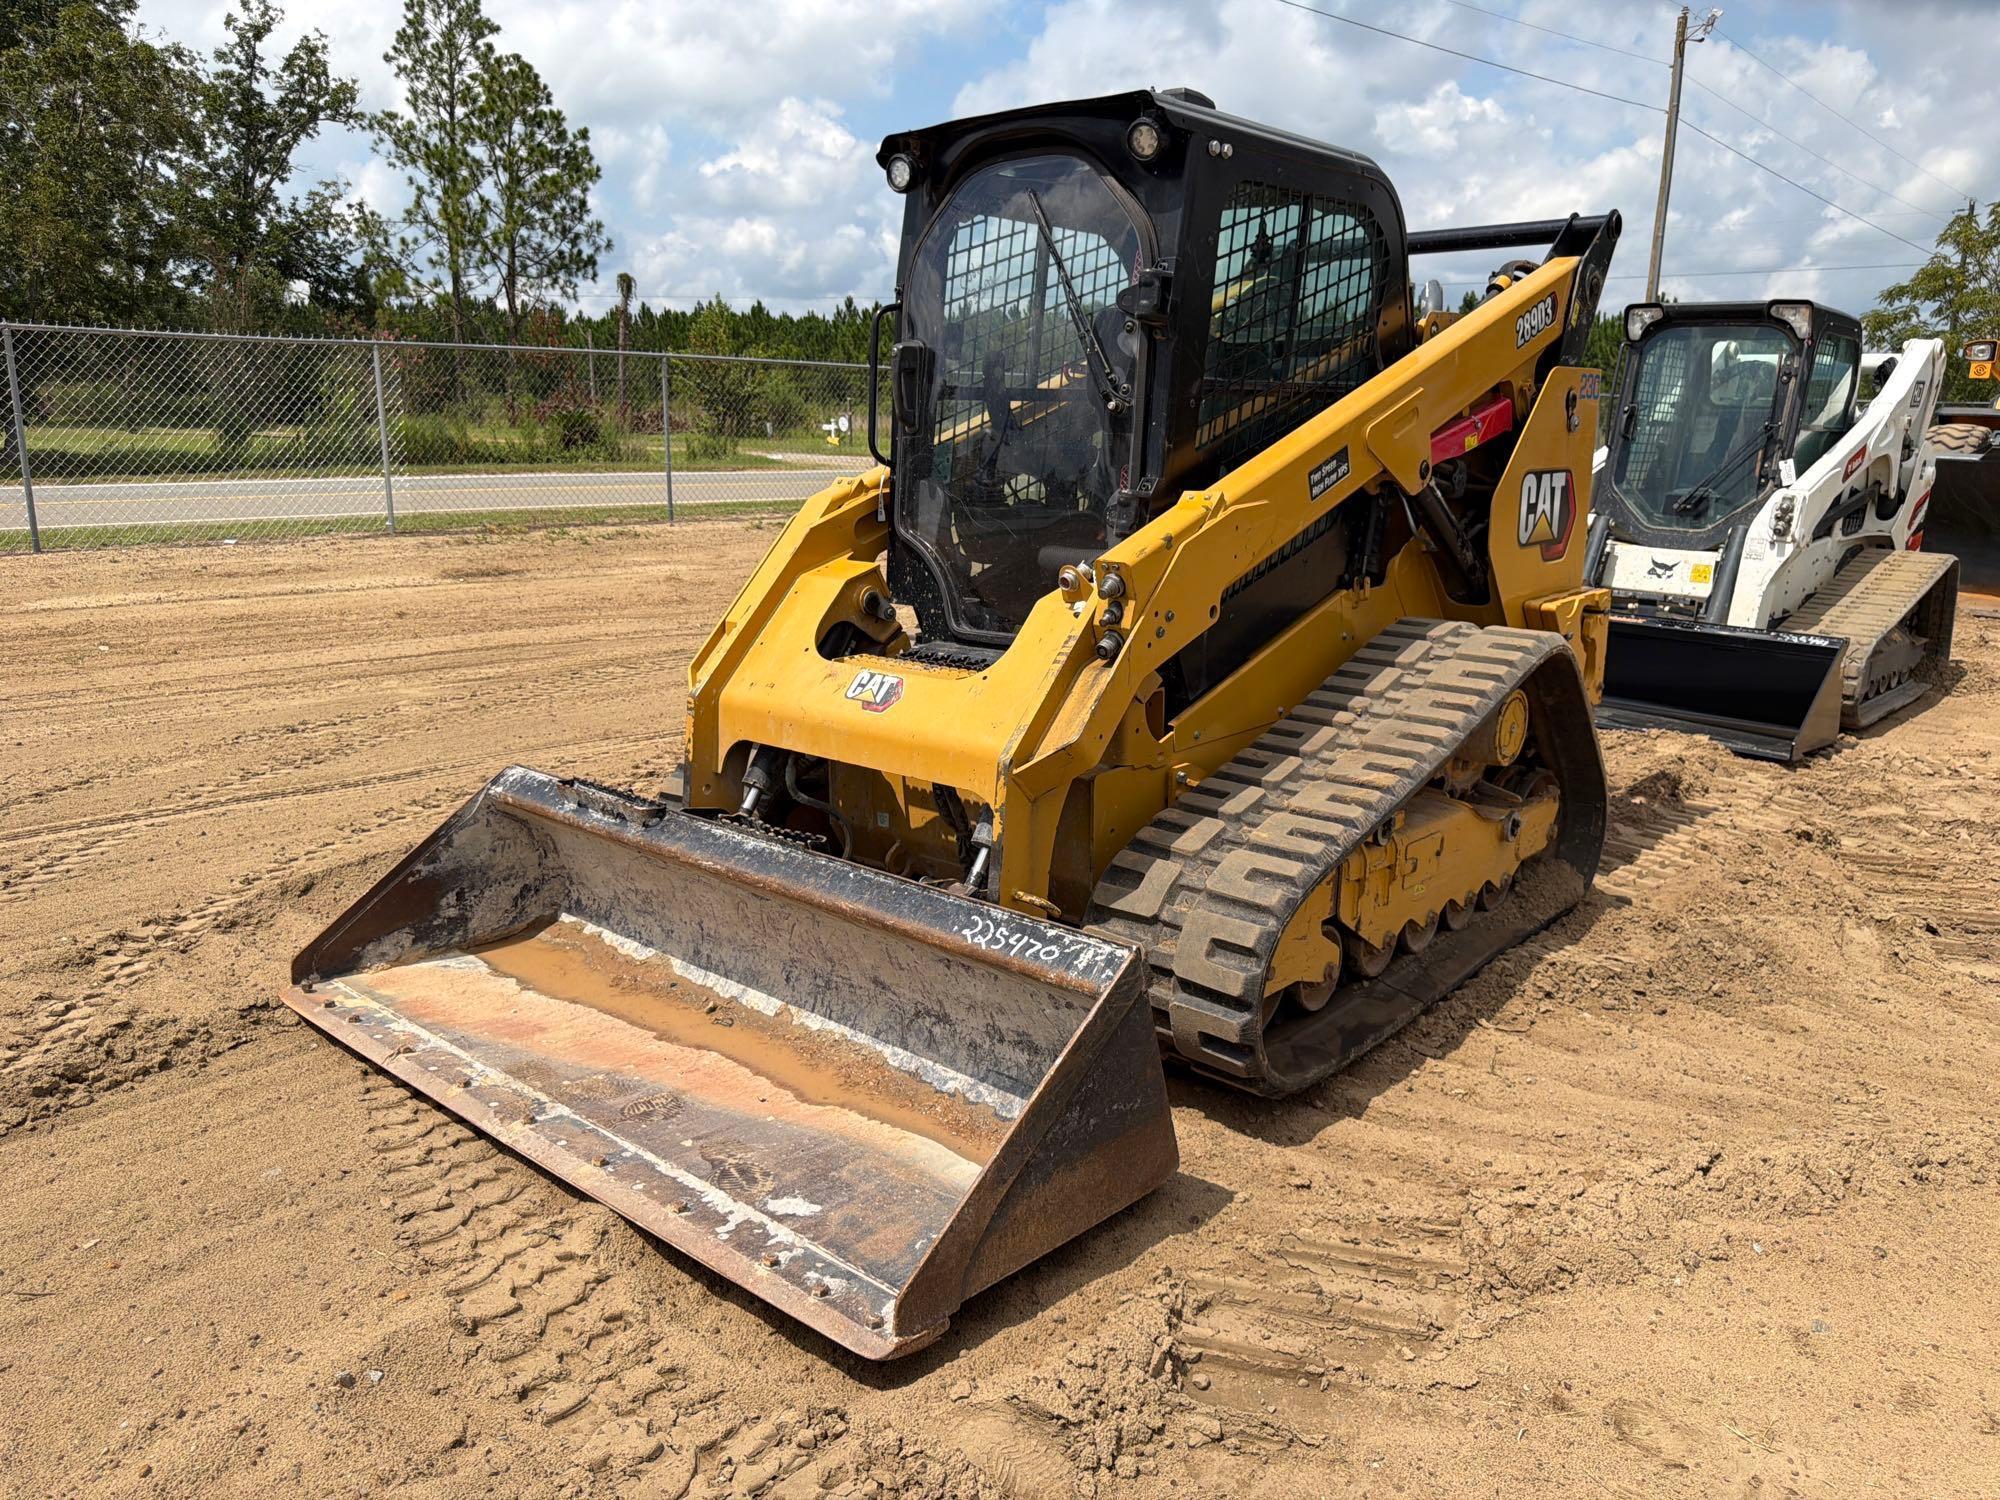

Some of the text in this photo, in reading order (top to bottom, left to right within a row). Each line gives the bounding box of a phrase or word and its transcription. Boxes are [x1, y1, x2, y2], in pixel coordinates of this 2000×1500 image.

[1515, 295, 1553, 348] 289D3
[1518, 471, 1567, 545] CAT
[845, 669, 901, 704] CAT
[961, 915, 1060, 961] 225470
